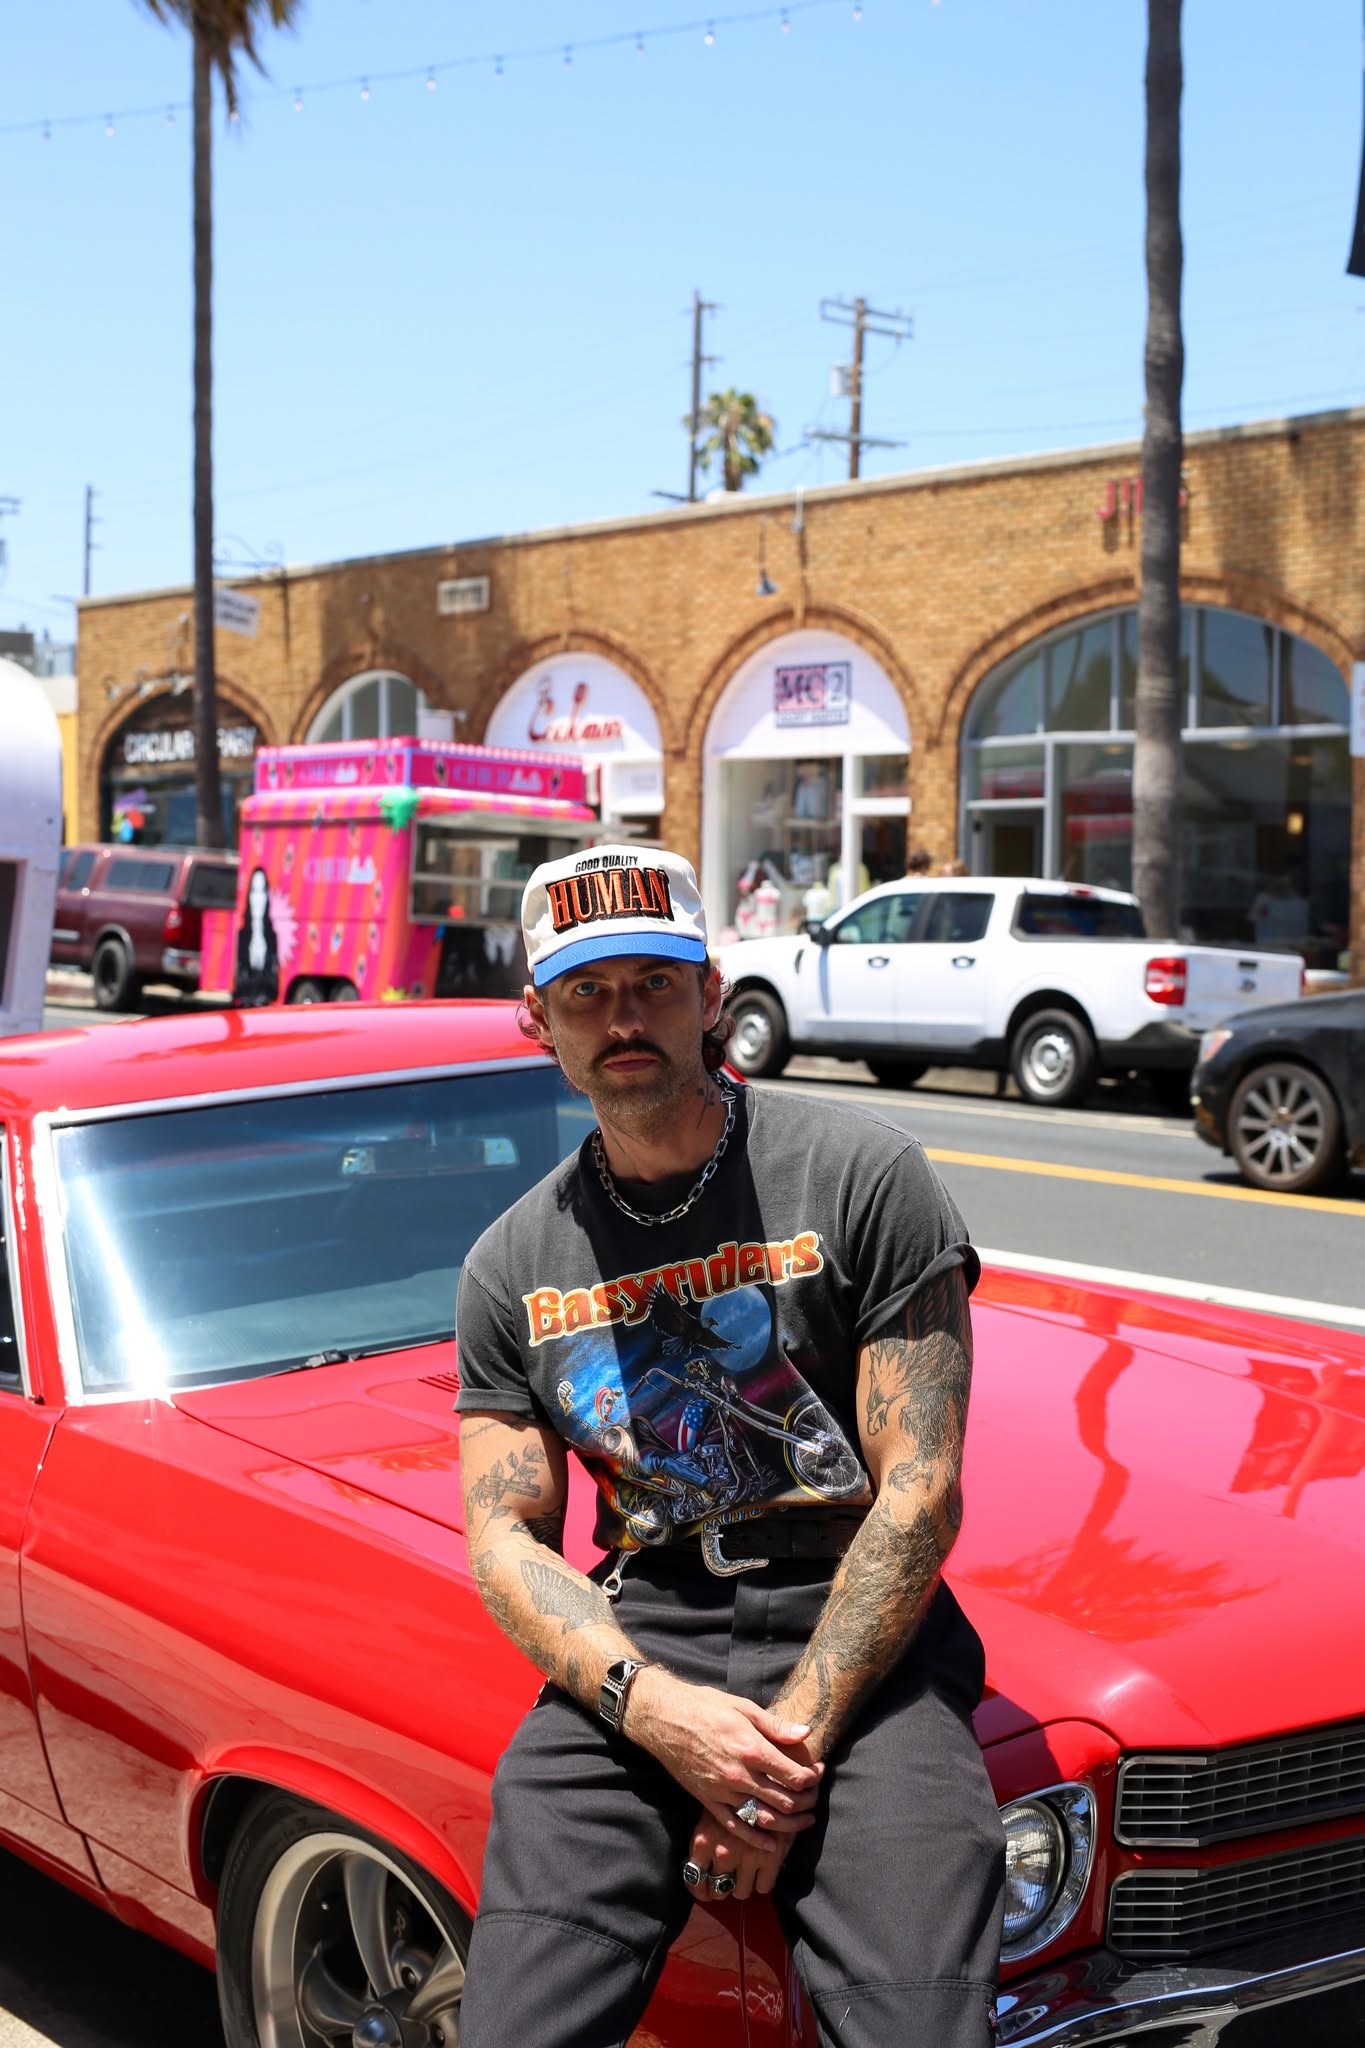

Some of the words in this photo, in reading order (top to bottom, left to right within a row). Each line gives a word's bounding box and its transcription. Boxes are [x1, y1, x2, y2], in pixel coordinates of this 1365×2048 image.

[575, 857, 600, 873] GOOD
[602, 855, 639, 869] QUALITY
[547, 867, 673, 933] HUMAN
[522, 1230, 824, 1347] Easyriders
